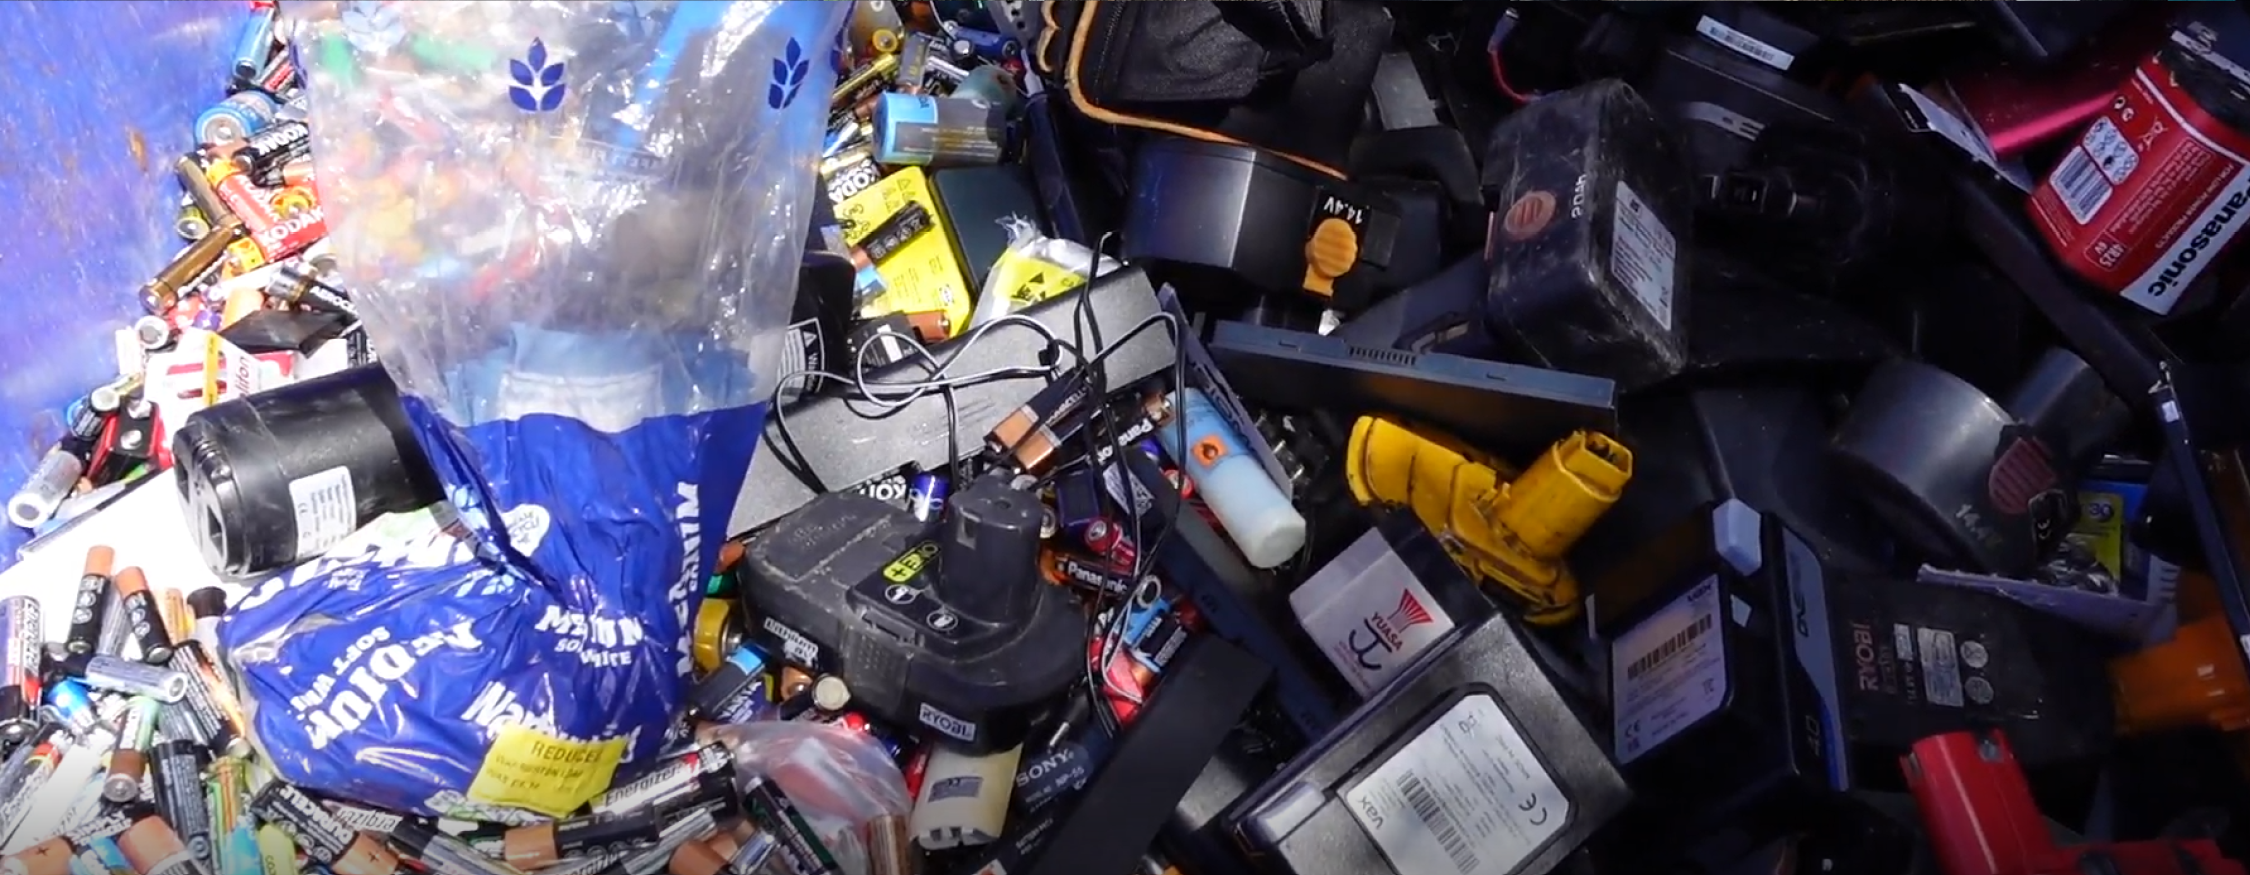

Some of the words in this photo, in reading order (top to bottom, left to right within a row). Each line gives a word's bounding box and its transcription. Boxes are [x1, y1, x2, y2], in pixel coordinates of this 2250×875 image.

[829, 159, 881, 203] KODA
[260, 206, 325, 246] KODAK
[1323, 196, 1363, 224] 14.4V
[1370, 611, 1404, 651] YUASA
[1852, 622, 1880, 692] RYOBI
[1015, 748, 1070, 787] SONY
[279, 784, 354, 846] DURACELL
[1357, 795, 1385, 831] vax
